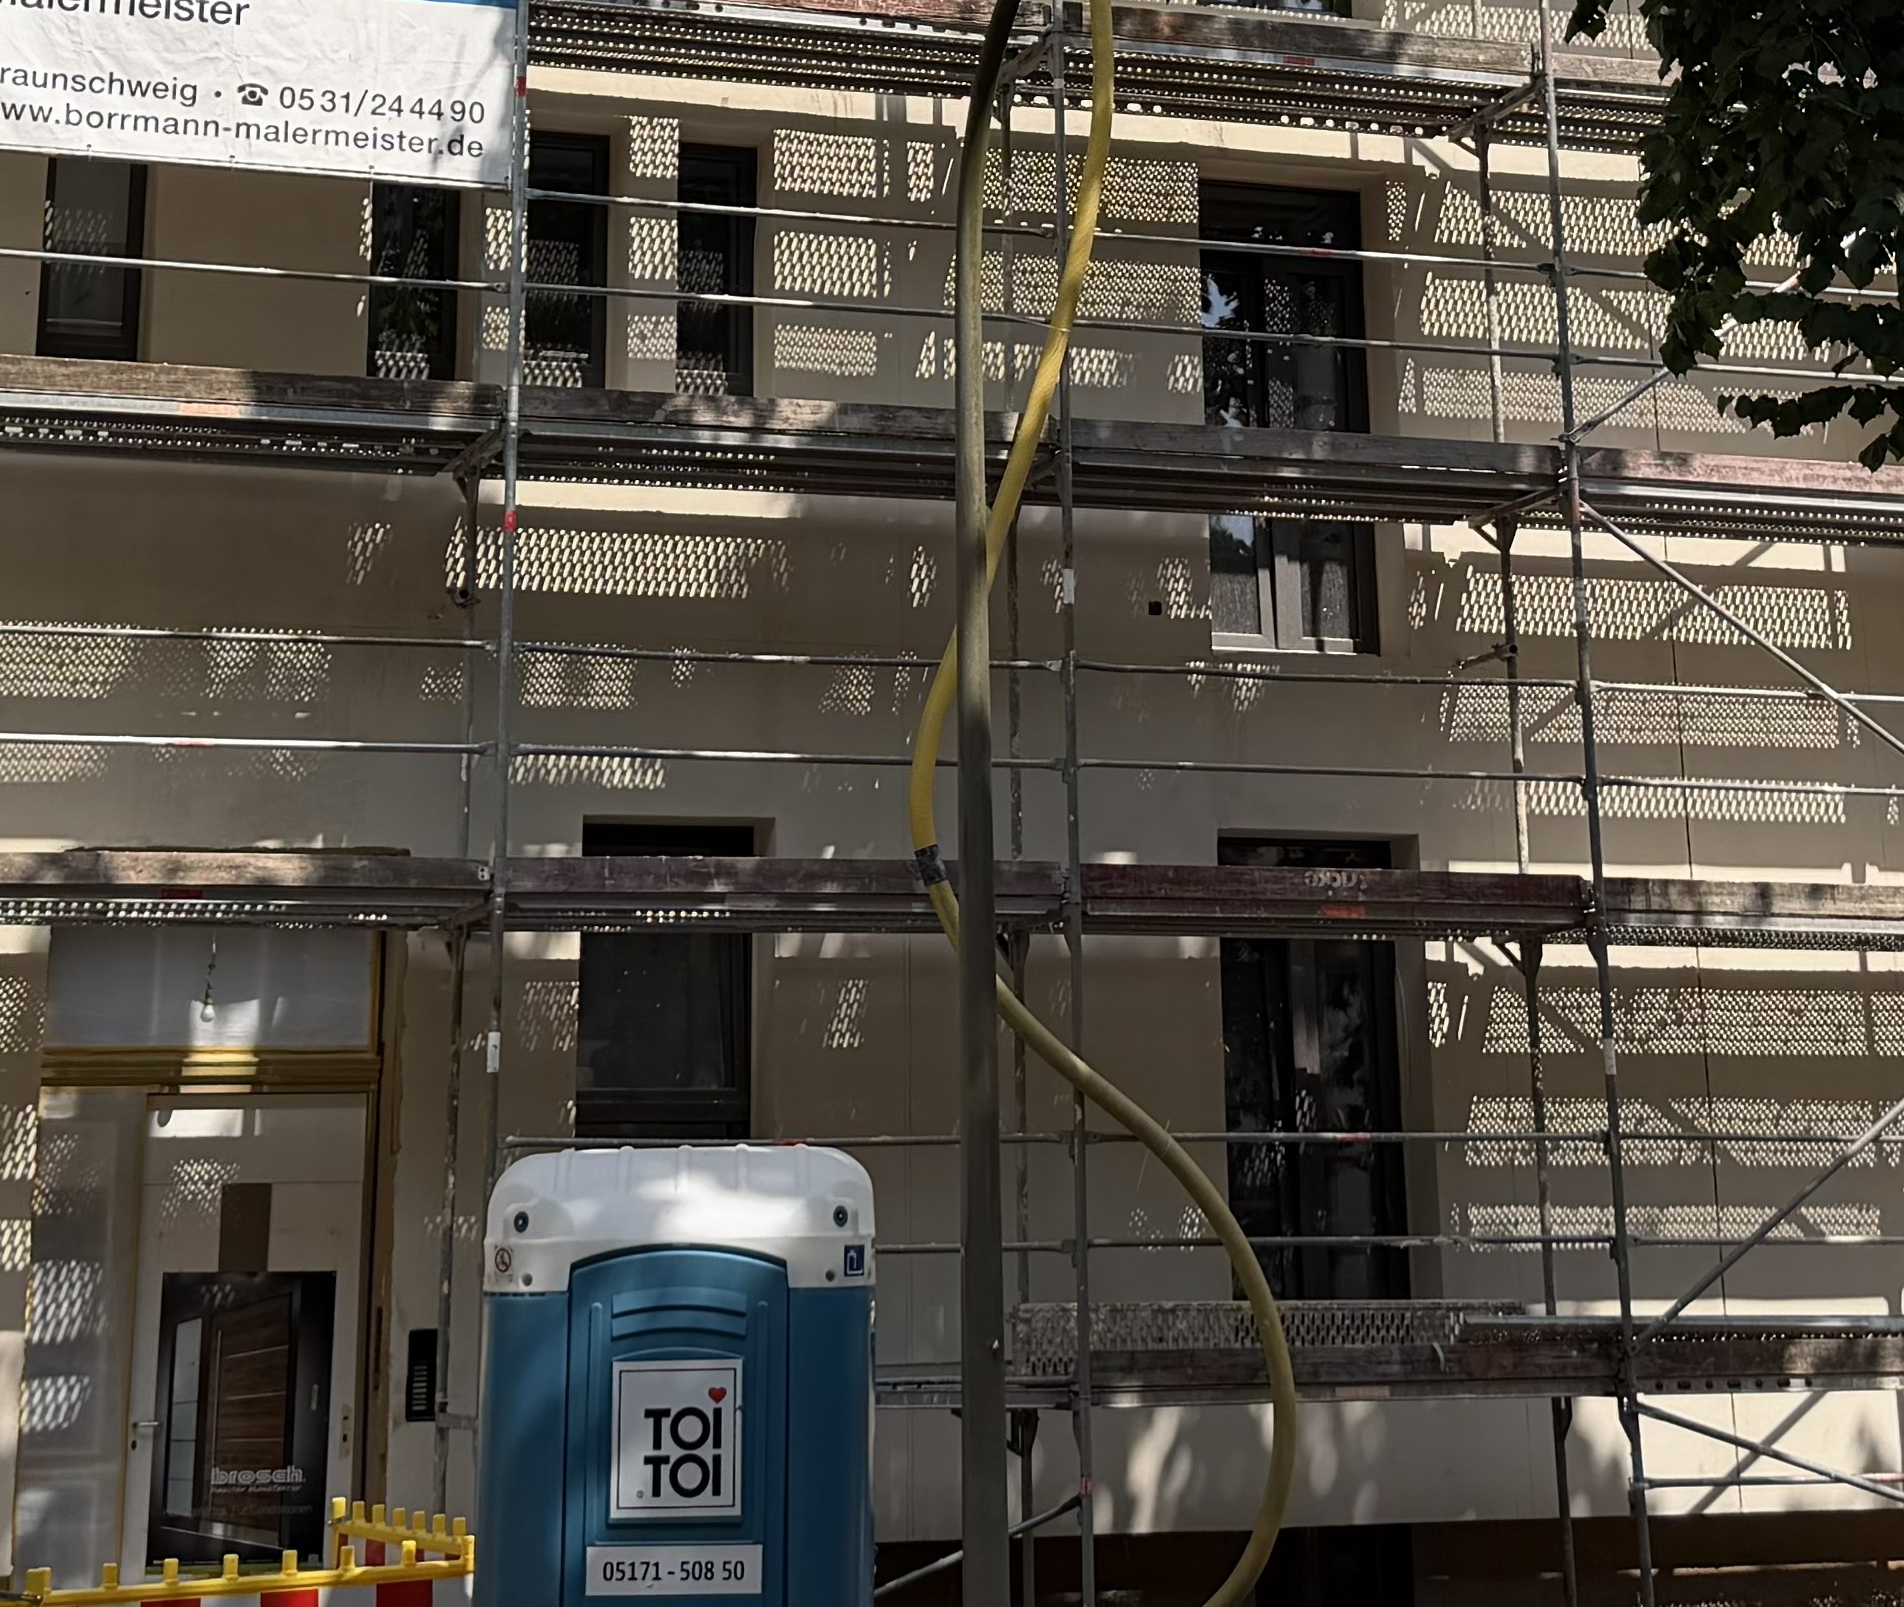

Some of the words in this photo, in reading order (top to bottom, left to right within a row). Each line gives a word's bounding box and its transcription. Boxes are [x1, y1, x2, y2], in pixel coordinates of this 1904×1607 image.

[643, 1406, 723, 1451] TOI
[643, 1453, 722, 1499] TOI
[602, 1560, 663, 1582] 05171
[679, 1560, 715, 1582] 508
[721, 1560, 746, 1581] 50
